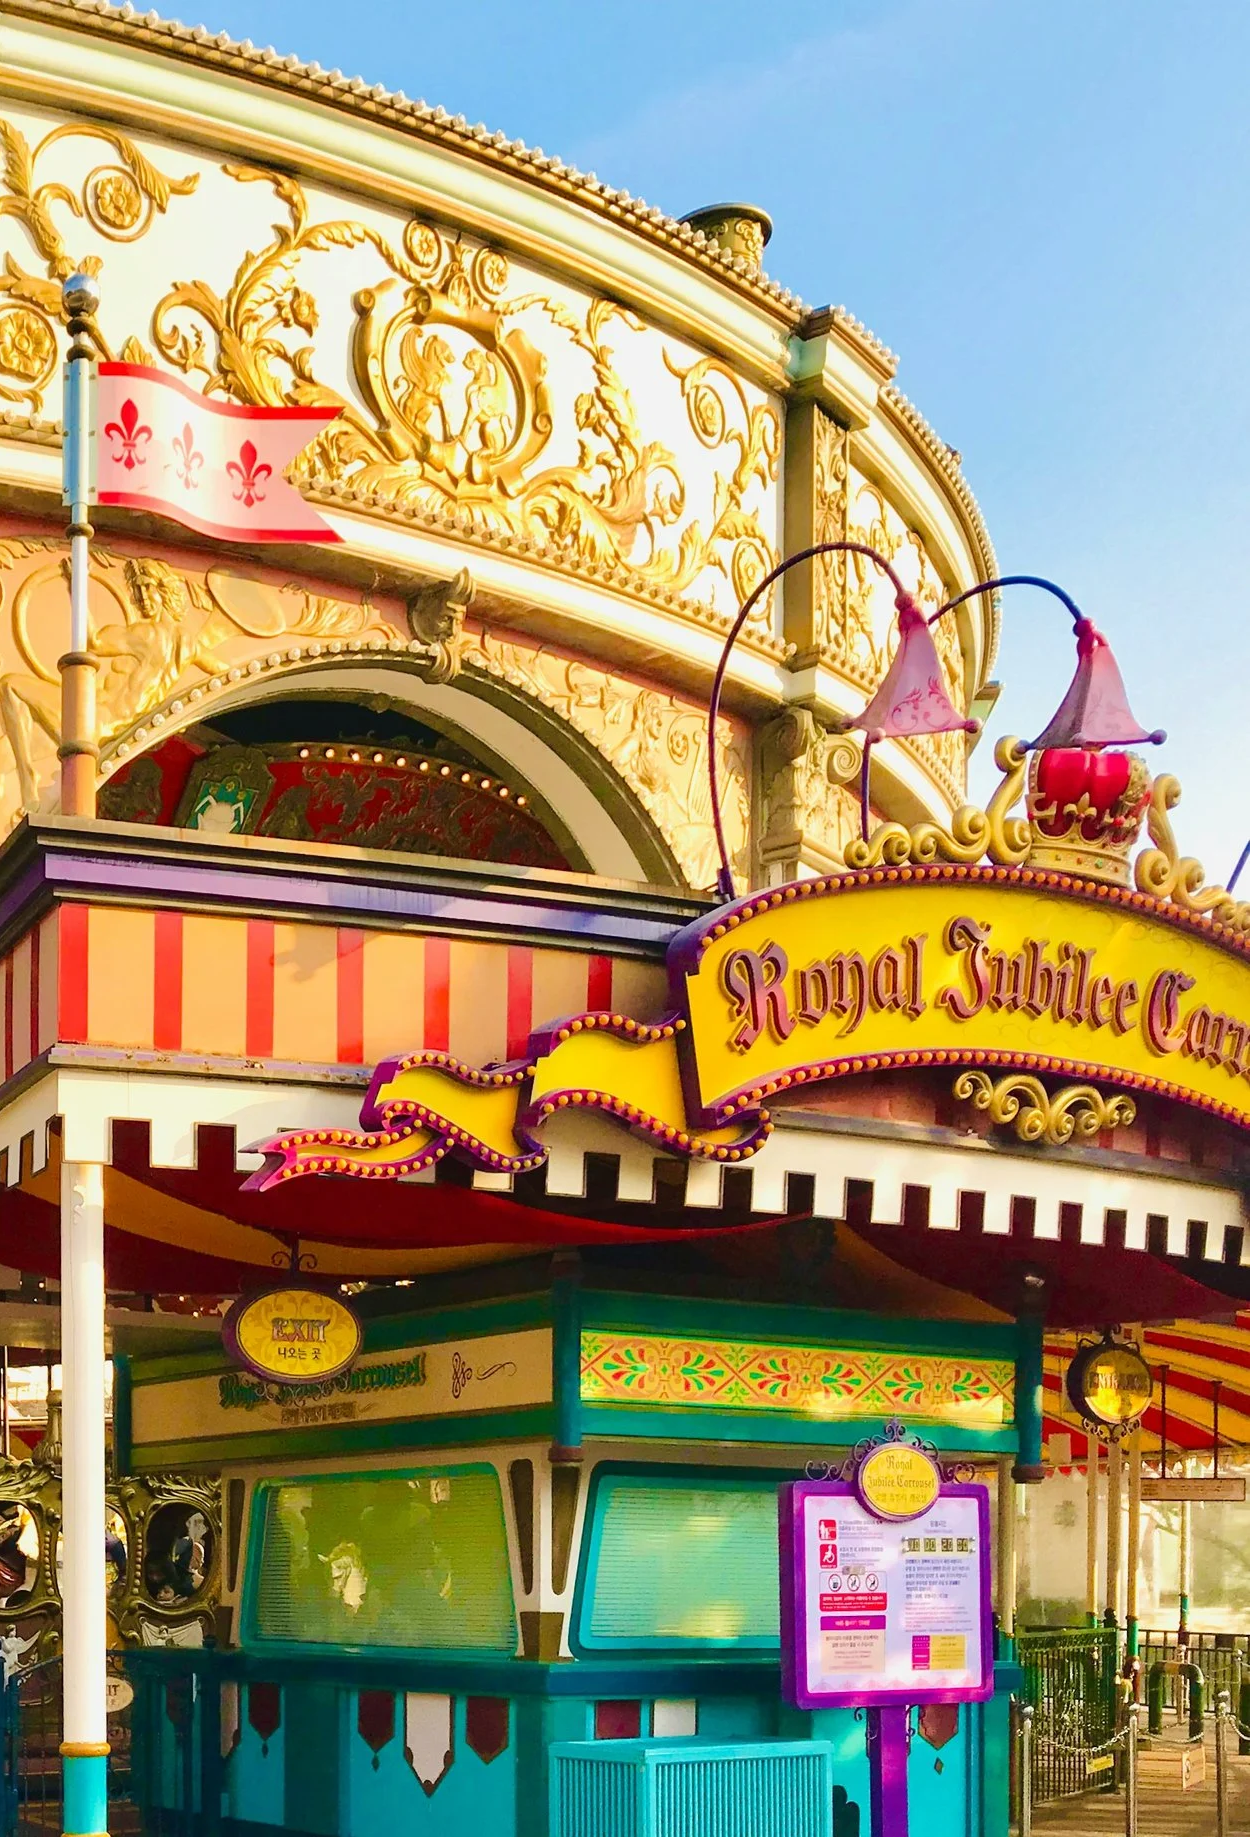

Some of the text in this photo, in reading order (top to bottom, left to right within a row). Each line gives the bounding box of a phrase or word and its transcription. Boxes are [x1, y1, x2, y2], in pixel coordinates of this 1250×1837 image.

[720, 932, 927, 1054] Royal
[935, 914, 1139, 1034] Jubilee
[271, 1317, 330, 1342] EXIT
[278, 1347, 321, 1360] 나오는 곳
[886, 1455, 912, 1471] Royal
